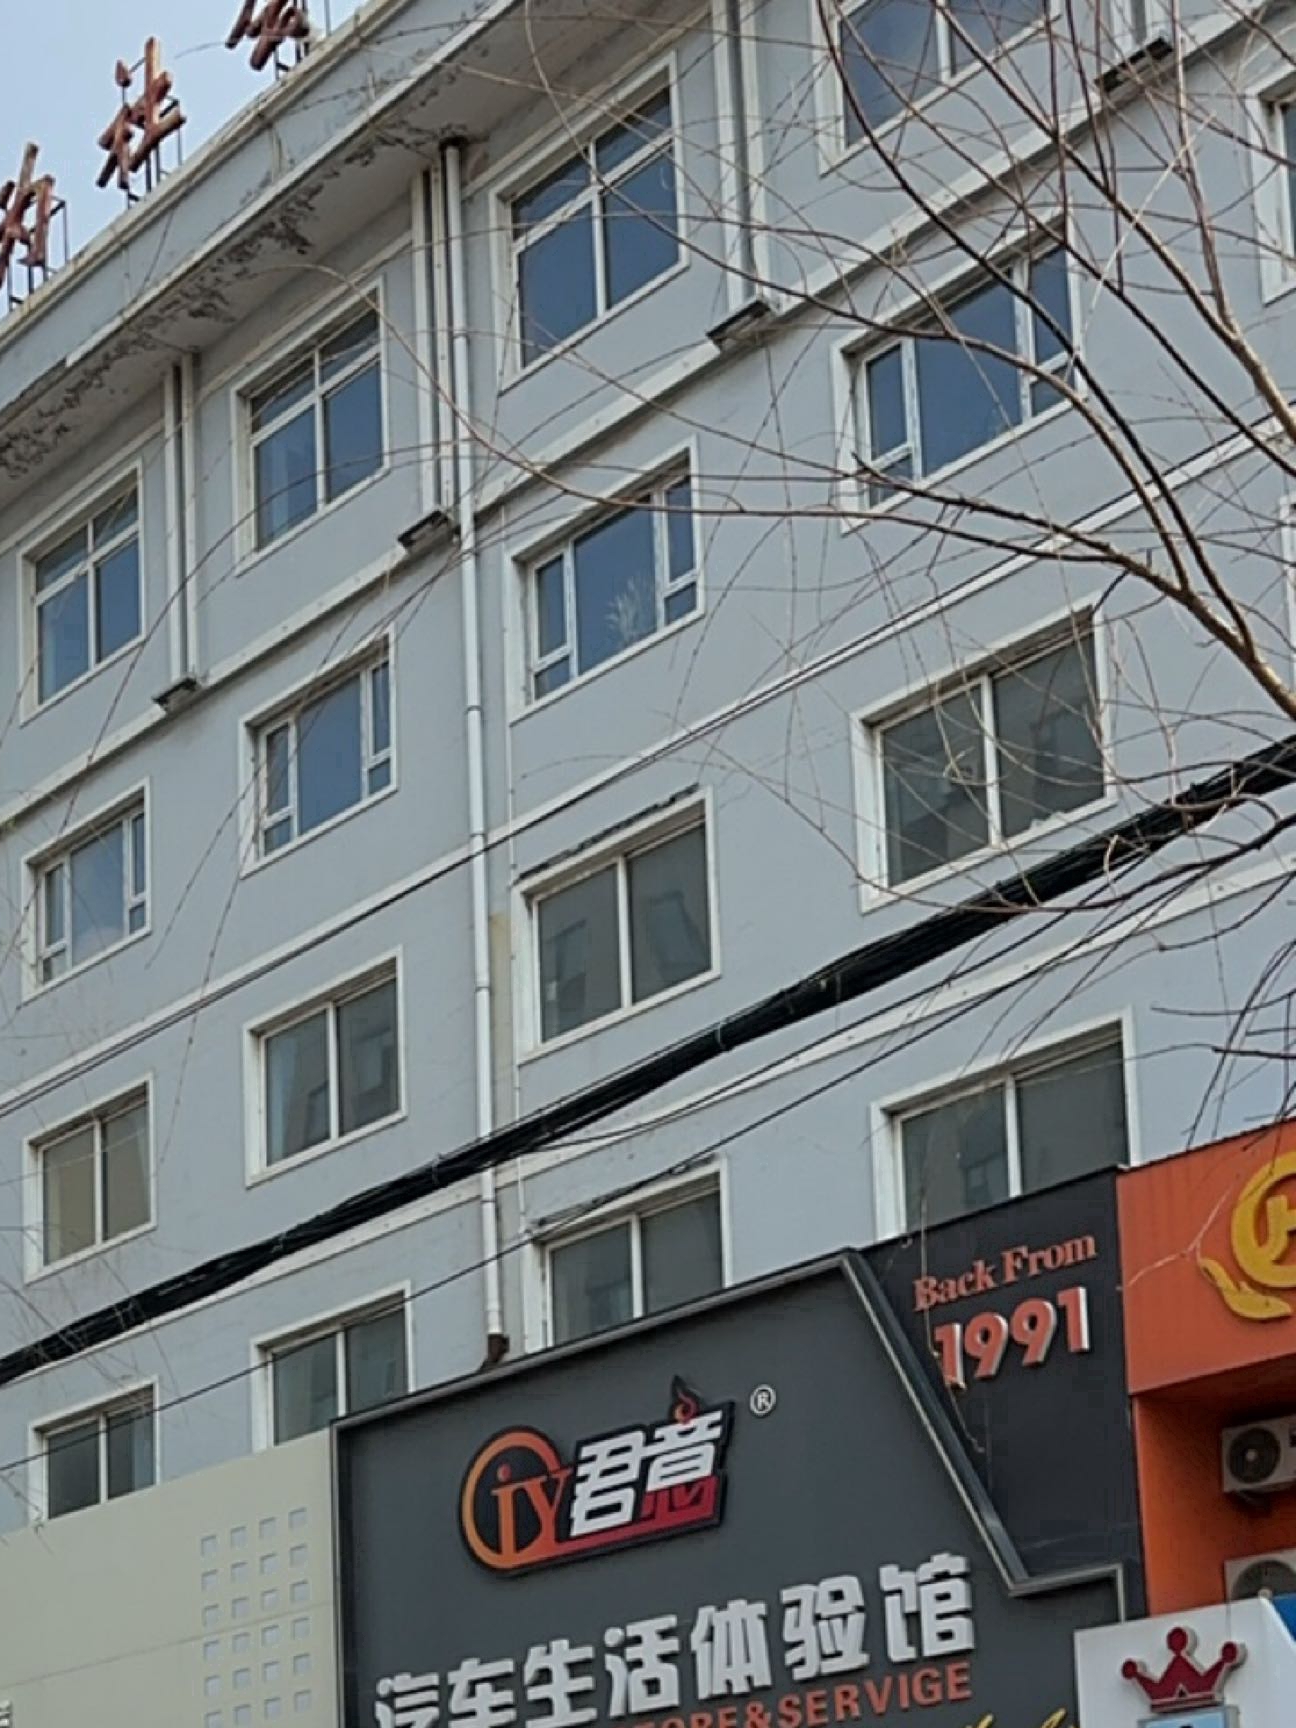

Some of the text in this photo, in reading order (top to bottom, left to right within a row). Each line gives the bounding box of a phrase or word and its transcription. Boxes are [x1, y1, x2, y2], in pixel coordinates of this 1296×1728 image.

[912, 1234, 1097, 1312] Back From
[934, 1286, 1091, 1390] 1991
